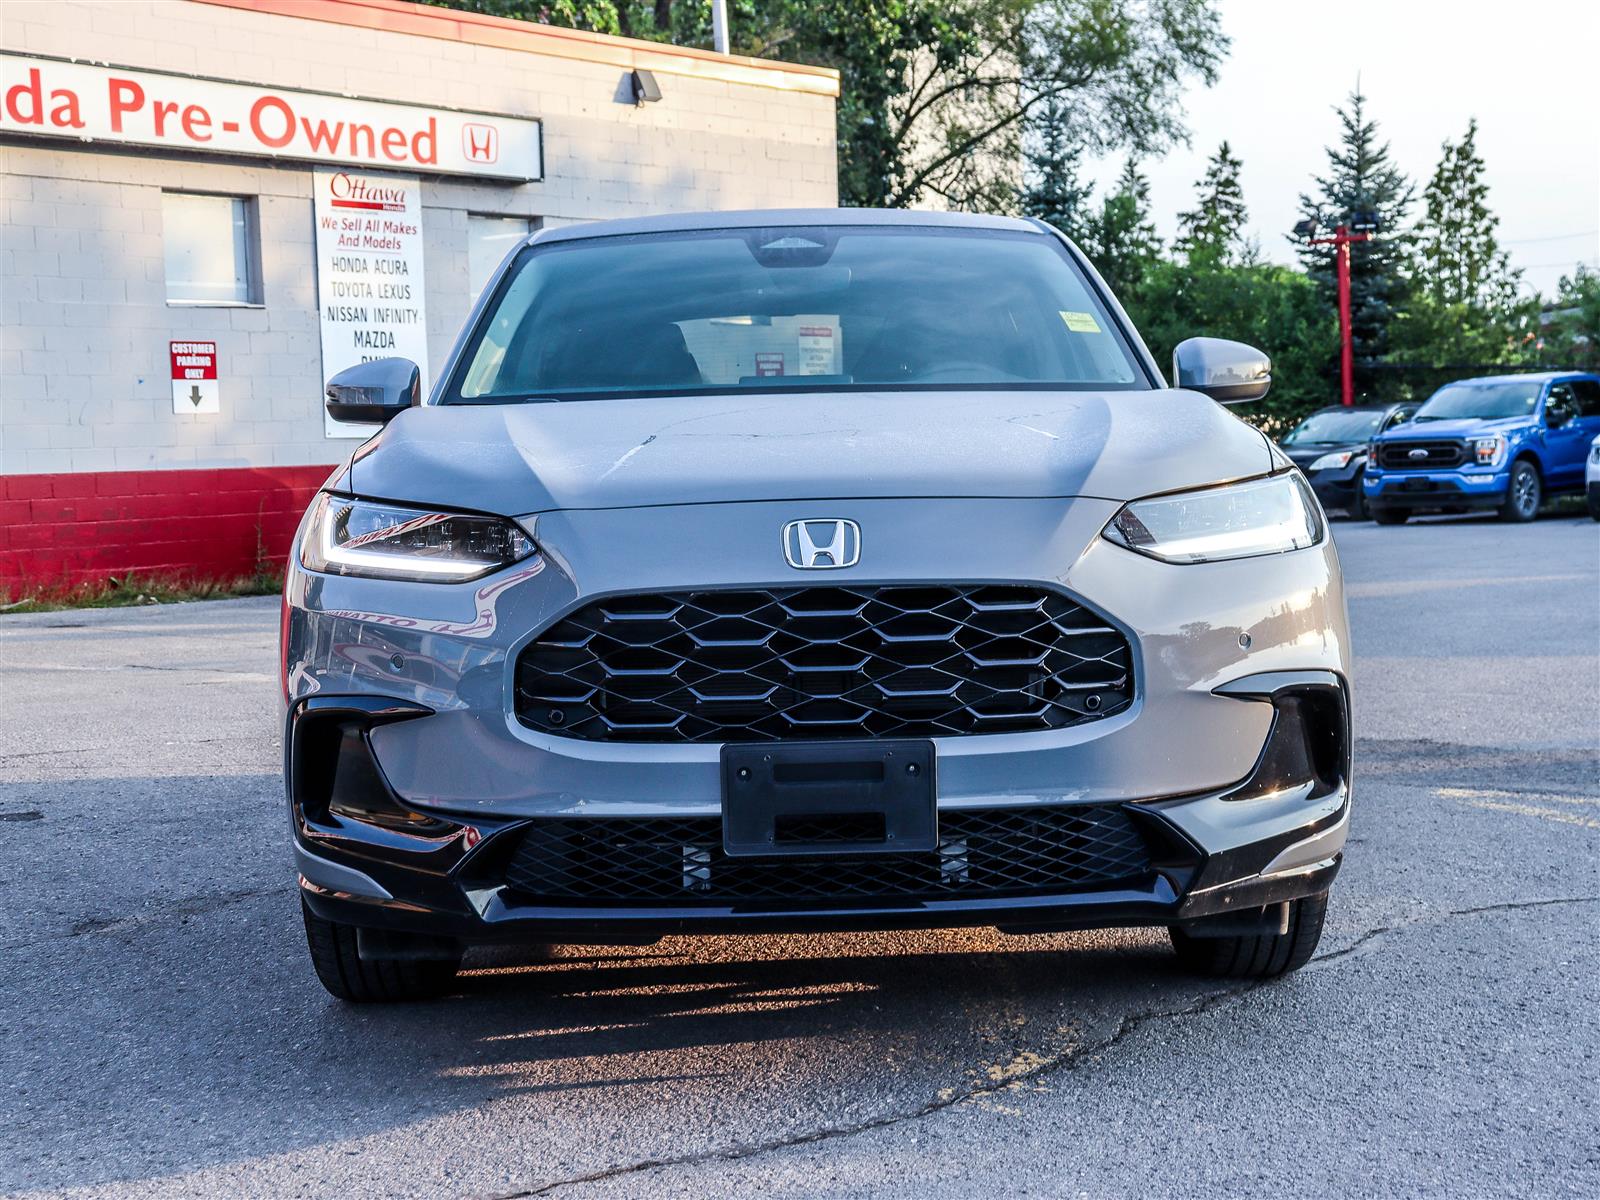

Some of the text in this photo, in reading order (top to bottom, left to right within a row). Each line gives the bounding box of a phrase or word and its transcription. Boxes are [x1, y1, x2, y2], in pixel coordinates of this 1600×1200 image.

[0, 67, 86, 129] da
[108, 77, 438, 165] Pre-Owned
[330, 171, 406, 203] Ottawa
[321, 217, 417, 235] We Sell All Makes
[337, 234, 401, 250] And Models
[331, 256, 409, 276] HONDA ACURA
[331, 281, 411, 300] TOYOTA LEXUS
[327, 306, 418, 324] NISSAN INFINITY
[171, 343, 215, 354] CUSTOMER
[354, 330, 396, 349] MAZDA
